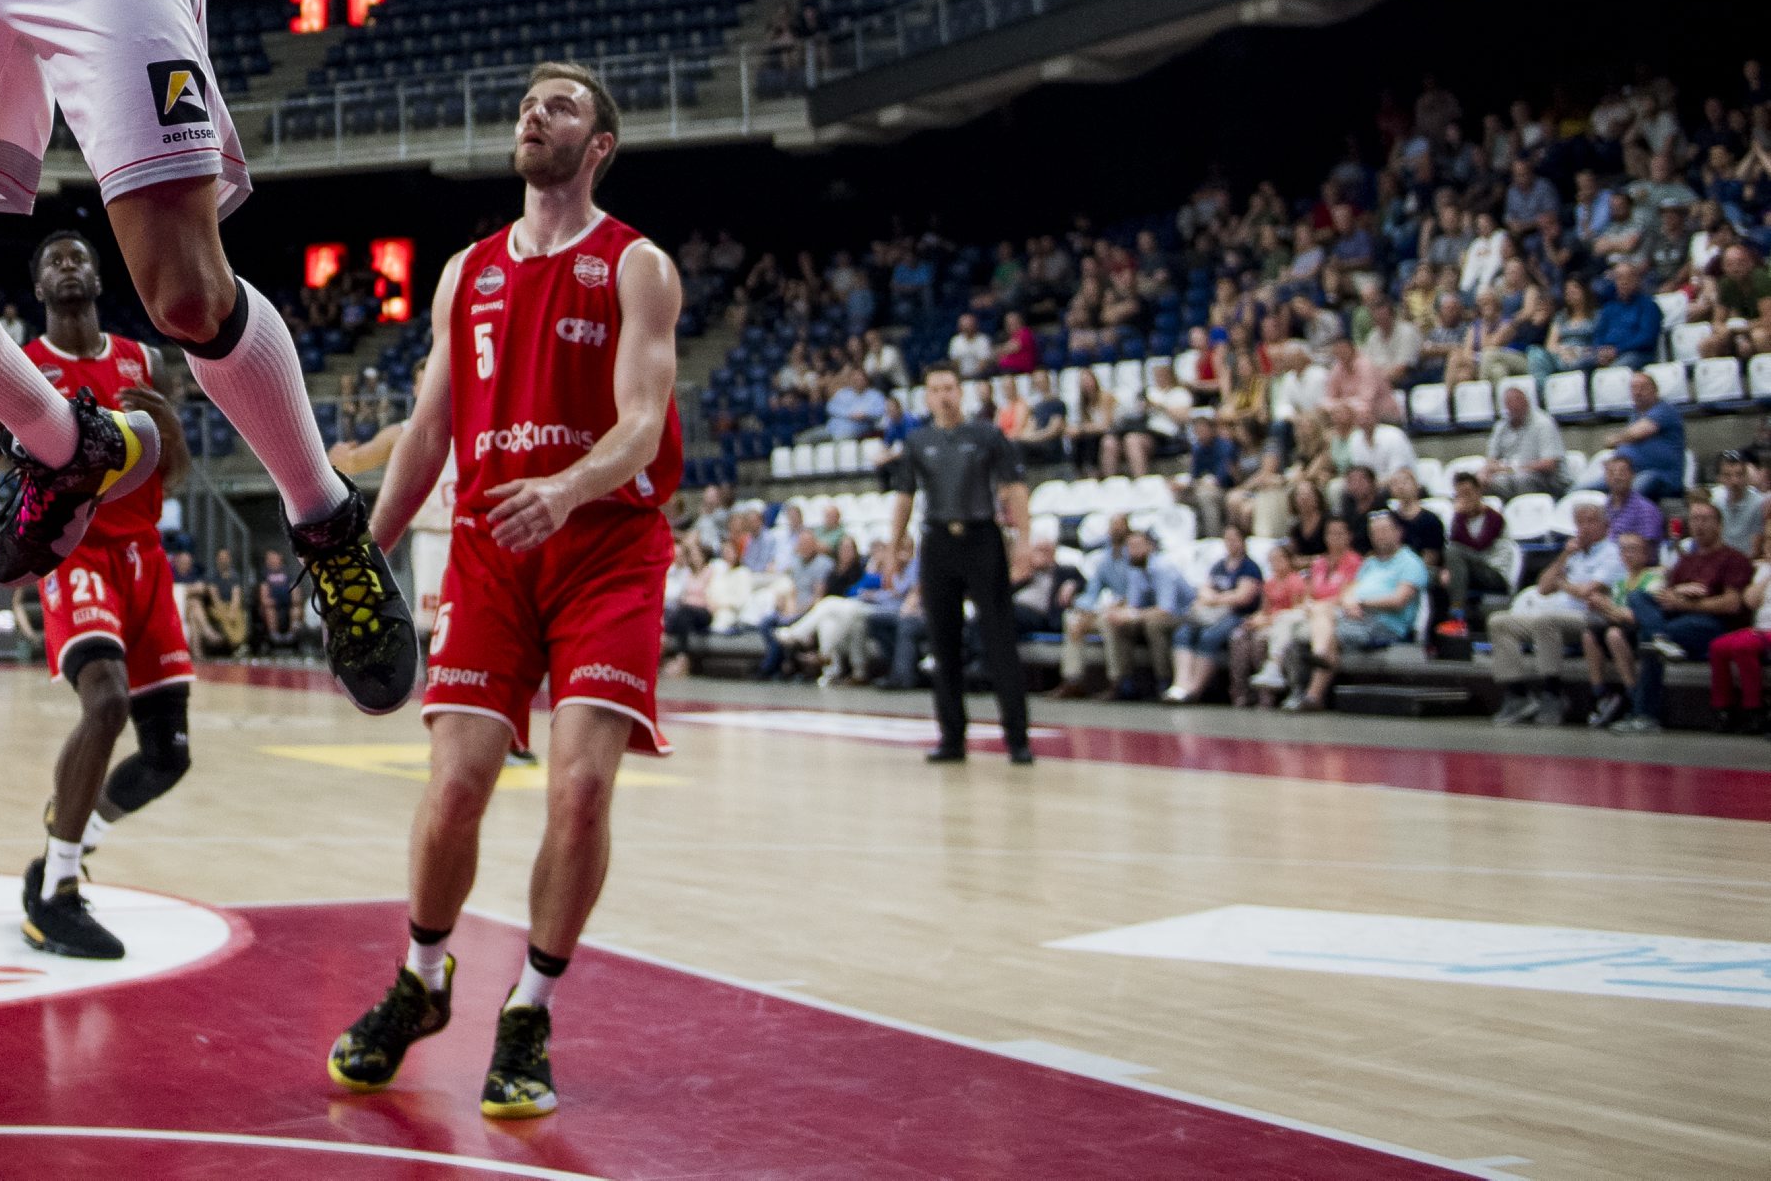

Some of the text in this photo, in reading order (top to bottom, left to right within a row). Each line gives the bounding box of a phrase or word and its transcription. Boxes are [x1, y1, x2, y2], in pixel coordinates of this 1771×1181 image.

[474, 323, 495, 380] 5
[475, 420, 594, 461] proximus
[69, 568, 106, 603] 21
[569, 662, 648, 694] proximus
